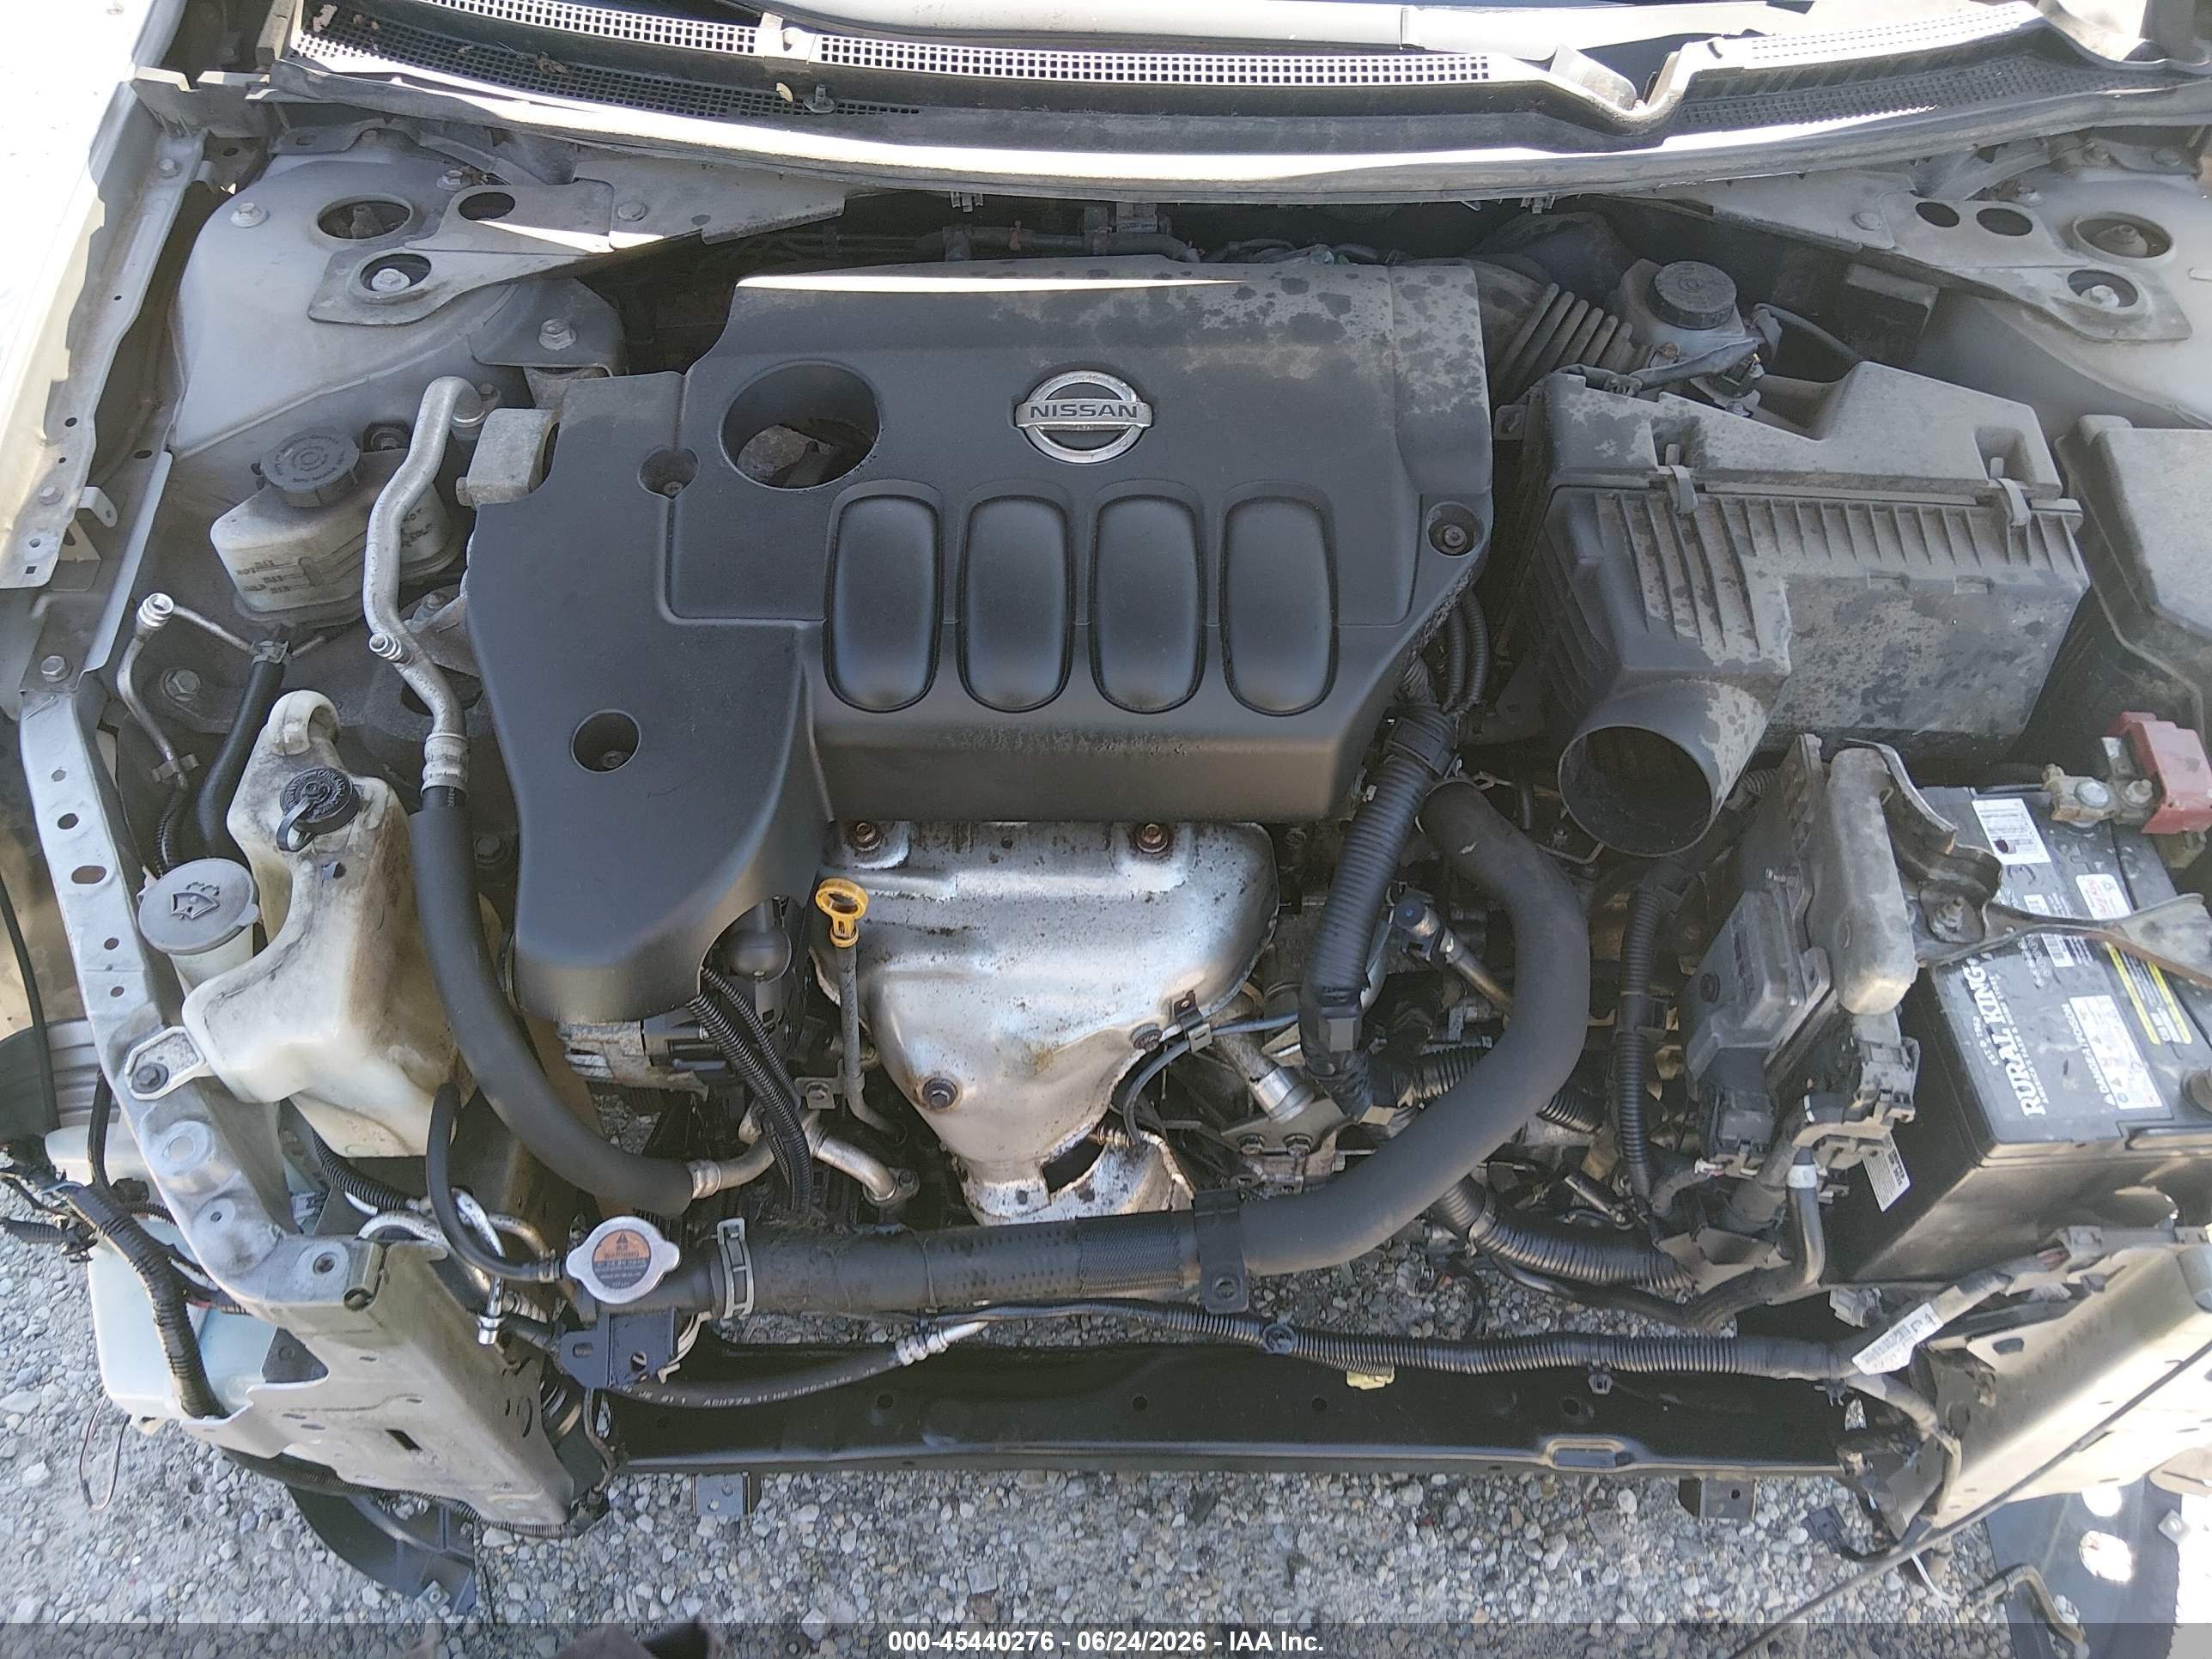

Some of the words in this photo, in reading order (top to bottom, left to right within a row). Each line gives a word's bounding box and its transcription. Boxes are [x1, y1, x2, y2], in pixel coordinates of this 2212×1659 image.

[1030, 404, 1138, 418] NISSAN
[1962, 965, 2007, 1024] KING
[1991, 1027, 2046, 1116] RURAL
